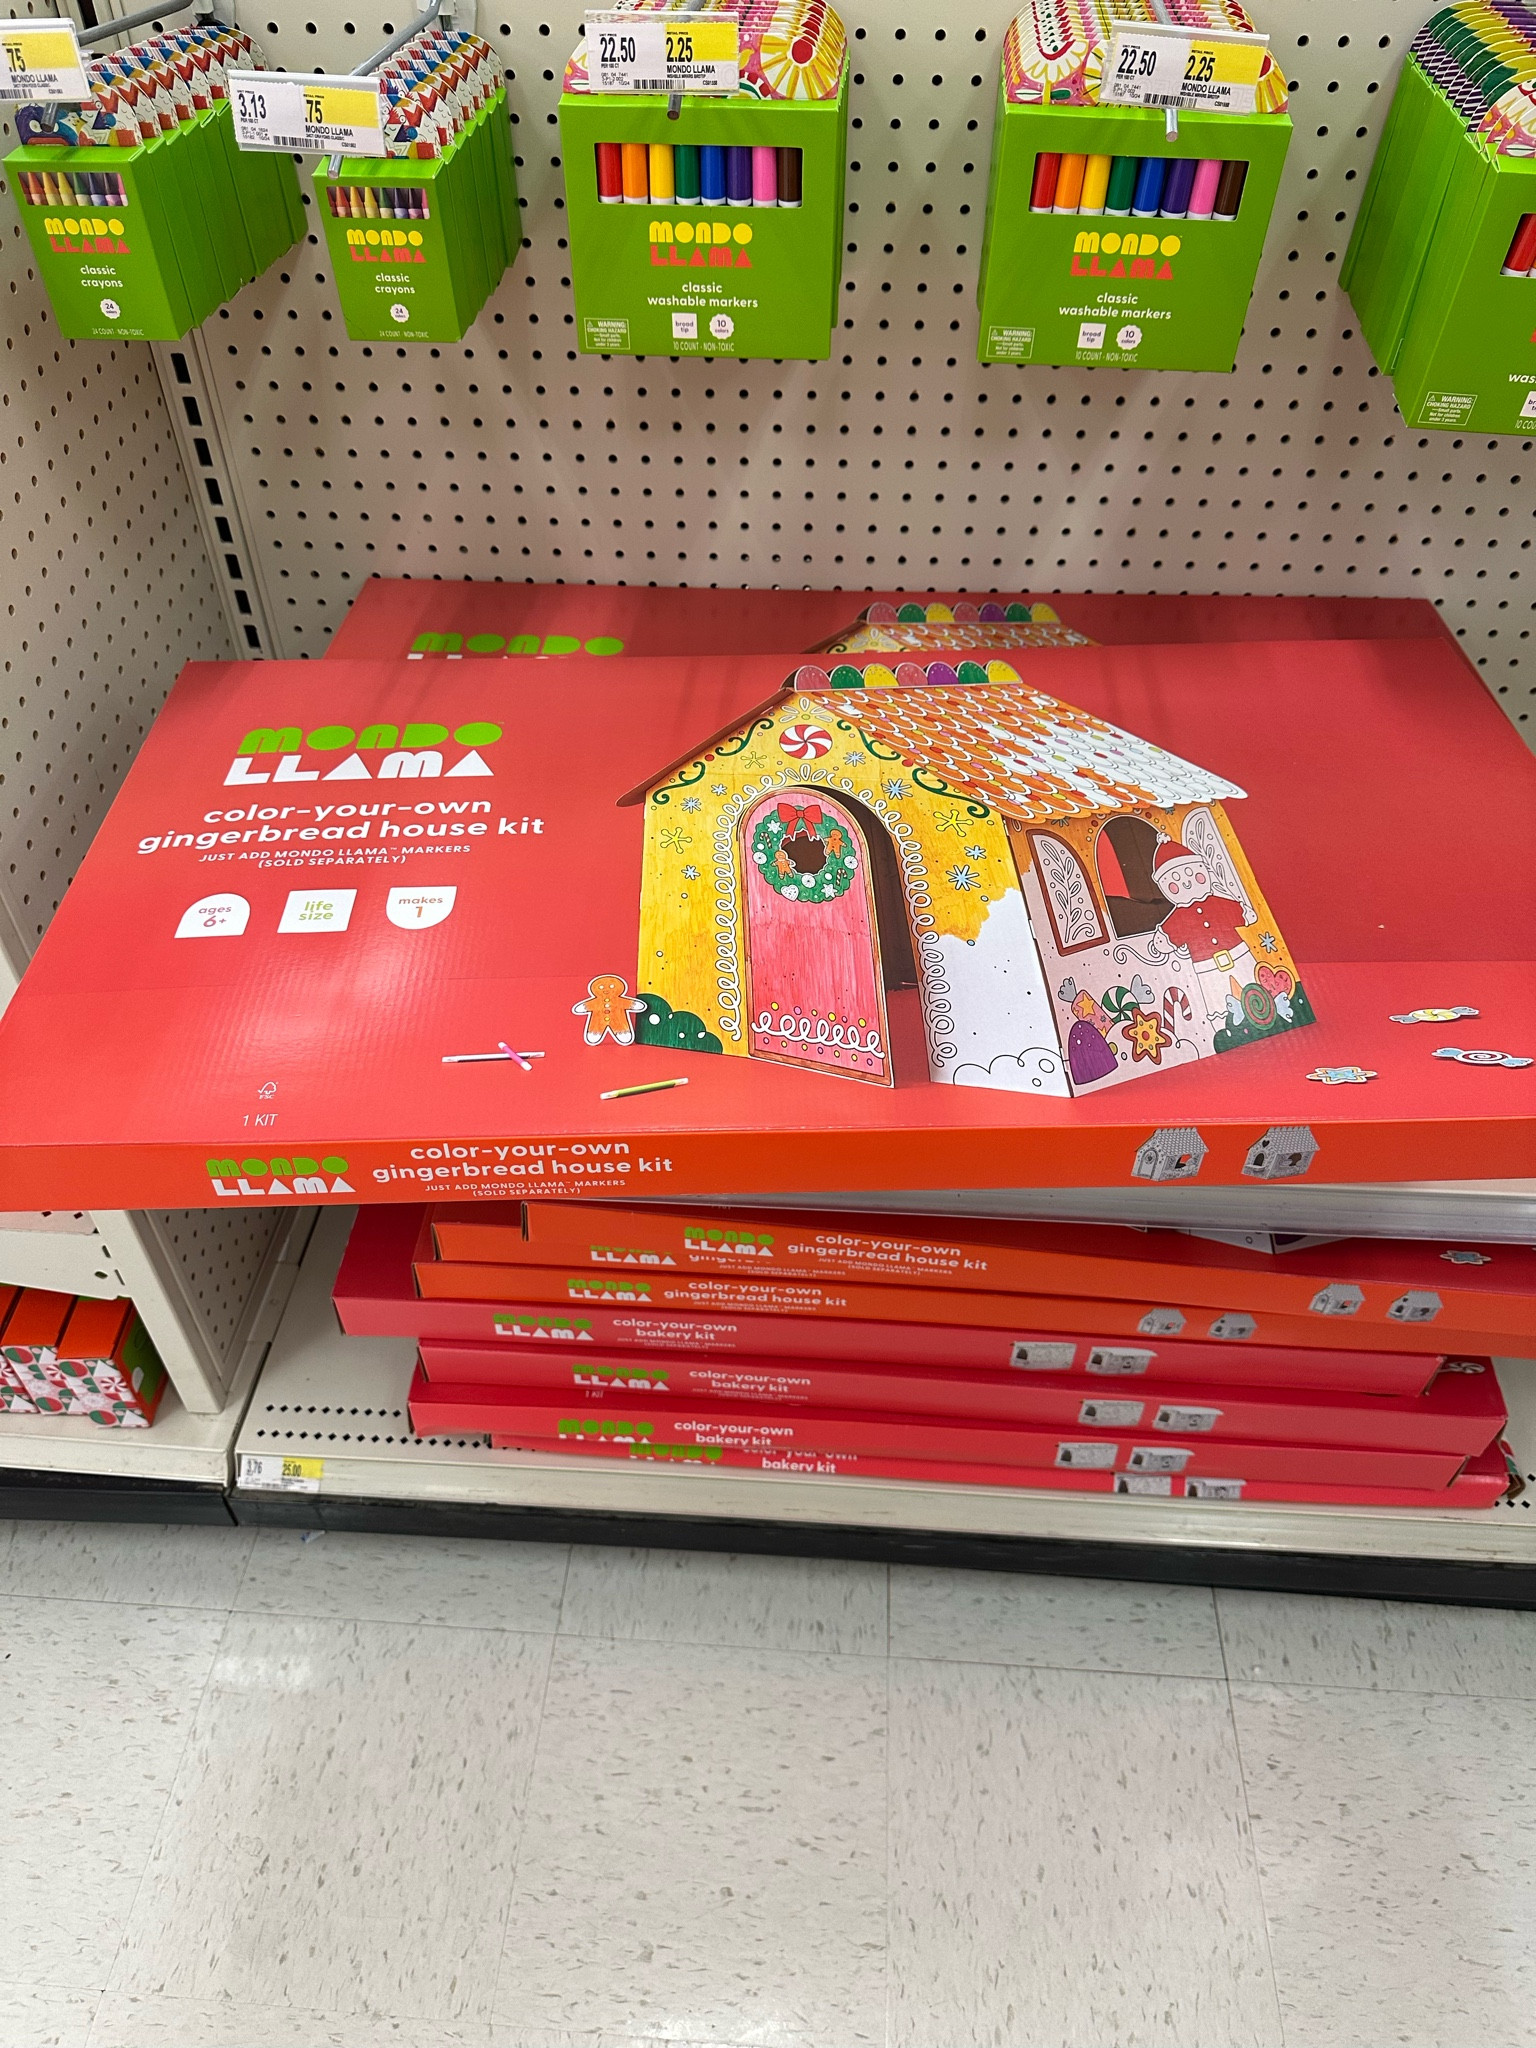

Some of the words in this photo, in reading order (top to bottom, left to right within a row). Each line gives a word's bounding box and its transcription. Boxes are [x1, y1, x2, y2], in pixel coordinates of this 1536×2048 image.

[600, 37, 636, 62] 22.50
[666, 37, 693, 62] 2.25
[6, 48, 26, 72] .75
[1118, 48, 1157, 76] 22.50
[667, 65, 691, 73] MONDO
[693, 65, 715, 73] LLAMA
[1184, 55, 1216, 82] 2.25
[11, 74, 36, 83] MONDO
[36, 74, 58, 82] LLAMA
[1181, 82, 1207, 93] MONDO
[1208, 85, 1231, 96] LLAMA
[238, 93, 267, 119] 3.13
[305, 99, 323, 124] .75
[305, 125, 330, 135] MONDO
[331, 127, 354, 137] LLAMA
[44, 217, 125, 235] MONDO
[649, 221, 752, 245] MONDO
[50, 235, 131, 254] LLAMA
[346, 229, 423, 246] MONDO
[1073, 231, 1181, 257] MONDO
[349, 245, 427, 263] LLAMA
[650, 244, 753, 268] LLAMA
[80, 265, 116, 275] classic
[1070, 254, 1174, 281] LLAMA
[81, 279, 123, 289] crayons
[376, 273, 410, 282] classic
[375, 285, 415, 295] crayons
[682, 282, 723, 293] classic
[647, 295, 706, 307] washable
[709, 297, 758, 308] markers
[1096, 292, 1138, 304] classic
[1059, 305, 1118, 318] washable
[1121, 307, 1172, 320] markers
[717, 319, 726, 328] 10
[1125, 330, 1134, 338] 10
[673, 341, 680, 350] 10
[680, 341, 700, 351] COUNT
[704, 342, 734, 352] NON-TOXIC
[1075, 351, 1082, 360] 10
[1082, 351, 1102, 361] COUNT
[1106, 352, 1138, 363] NON-TOXIC
[411, 631, 624, 656] MONDO
[237, 722, 503, 754] MONDO
[223, 750, 495, 786] LLAMA
[203, 800, 492, 823] color-your-own
[137, 821, 371, 855] gingerbread
[379, 820, 488, 838] house
[498, 817, 545, 835] kit
[199, 852, 235, 862] JUST
[238, 851, 270, 860] ADD
[274, 849, 334, 858] MONDO
[401, 845, 471, 854] MARKERS
[258, 859, 303, 868] (SOLD
[308, 855, 406, 866] SEPARATELY)
[304, 901, 333, 911] life
[398, 896, 444, 905] makes
[198, 905, 232, 915] ages
[299, 911, 333, 921] size
[415, 906, 423, 918] 1
[203, 915, 227, 928] 6+
[243, 1115, 250, 1126] 1
[254, 1114, 278, 1126] KIT
[410, 1142, 630, 1161] color-your-own
[206, 1156, 349, 1177] MONDO
[372, 1160, 544, 1183] gingerbread
[552, 1158, 631, 1175] house
[639, 1157, 673, 1173] kit
[211, 1176, 357, 1197] LLAMA
[425, 1184, 451, 1192] JUST
[481, 1182, 525, 1190] MONDO
[574, 1179, 626, 1187] MARKERS
[473, 1189, 506, 1197] (SOLD
[509, 1187, 581, 1196] SEPARATELY)
[684, 1226, 774, 1246] MONDO
[684, 1238, 774, 1257] LLAMA
[815, 1234, 961, 1257] color-your-own
[590, 1250, 677, 1266] LLAMA
[787, 1243, 901, 1262] gingerbread
[905, 1252, 960, 1268] house
[964, 1259, 988, 1271] kit
[567, 1278, 650, 1293] MONDO
[688, 1281, 822, 1296] color-your-own
[568, 1288, 652, 1302] LLAMA
[664, 1289, 769, 1302] gingerbread
[772, 1291, 823, 1304] house
[825, 1296, 848, 1306] kit
[494, 1323, 594, 1341] LLAMA
[613, 1318, 738, 1333] color-your-own
[636, 1329, 692, 1341] bakery
[695, 1330, 715, 1340] kit
[573, 1373, 670, 1391] LLAMA
[689, 1369, 811, 1386] color-your-own
[711, 1380, 766, 1392] bakery
[768, 1382, 789, 1393] kit
[558, 1419, 654, 1436] MONDO
[673, 1420, 794, 1436] color-your-own
[695, 1433, 750, 1446] bakery
[752, 1435, 772, 1446] kit
[282, 1464, 302, 1477] 25.00
[762, 1457, 814, 1472] bakery
[817, 1460, 836, 1473] kit
